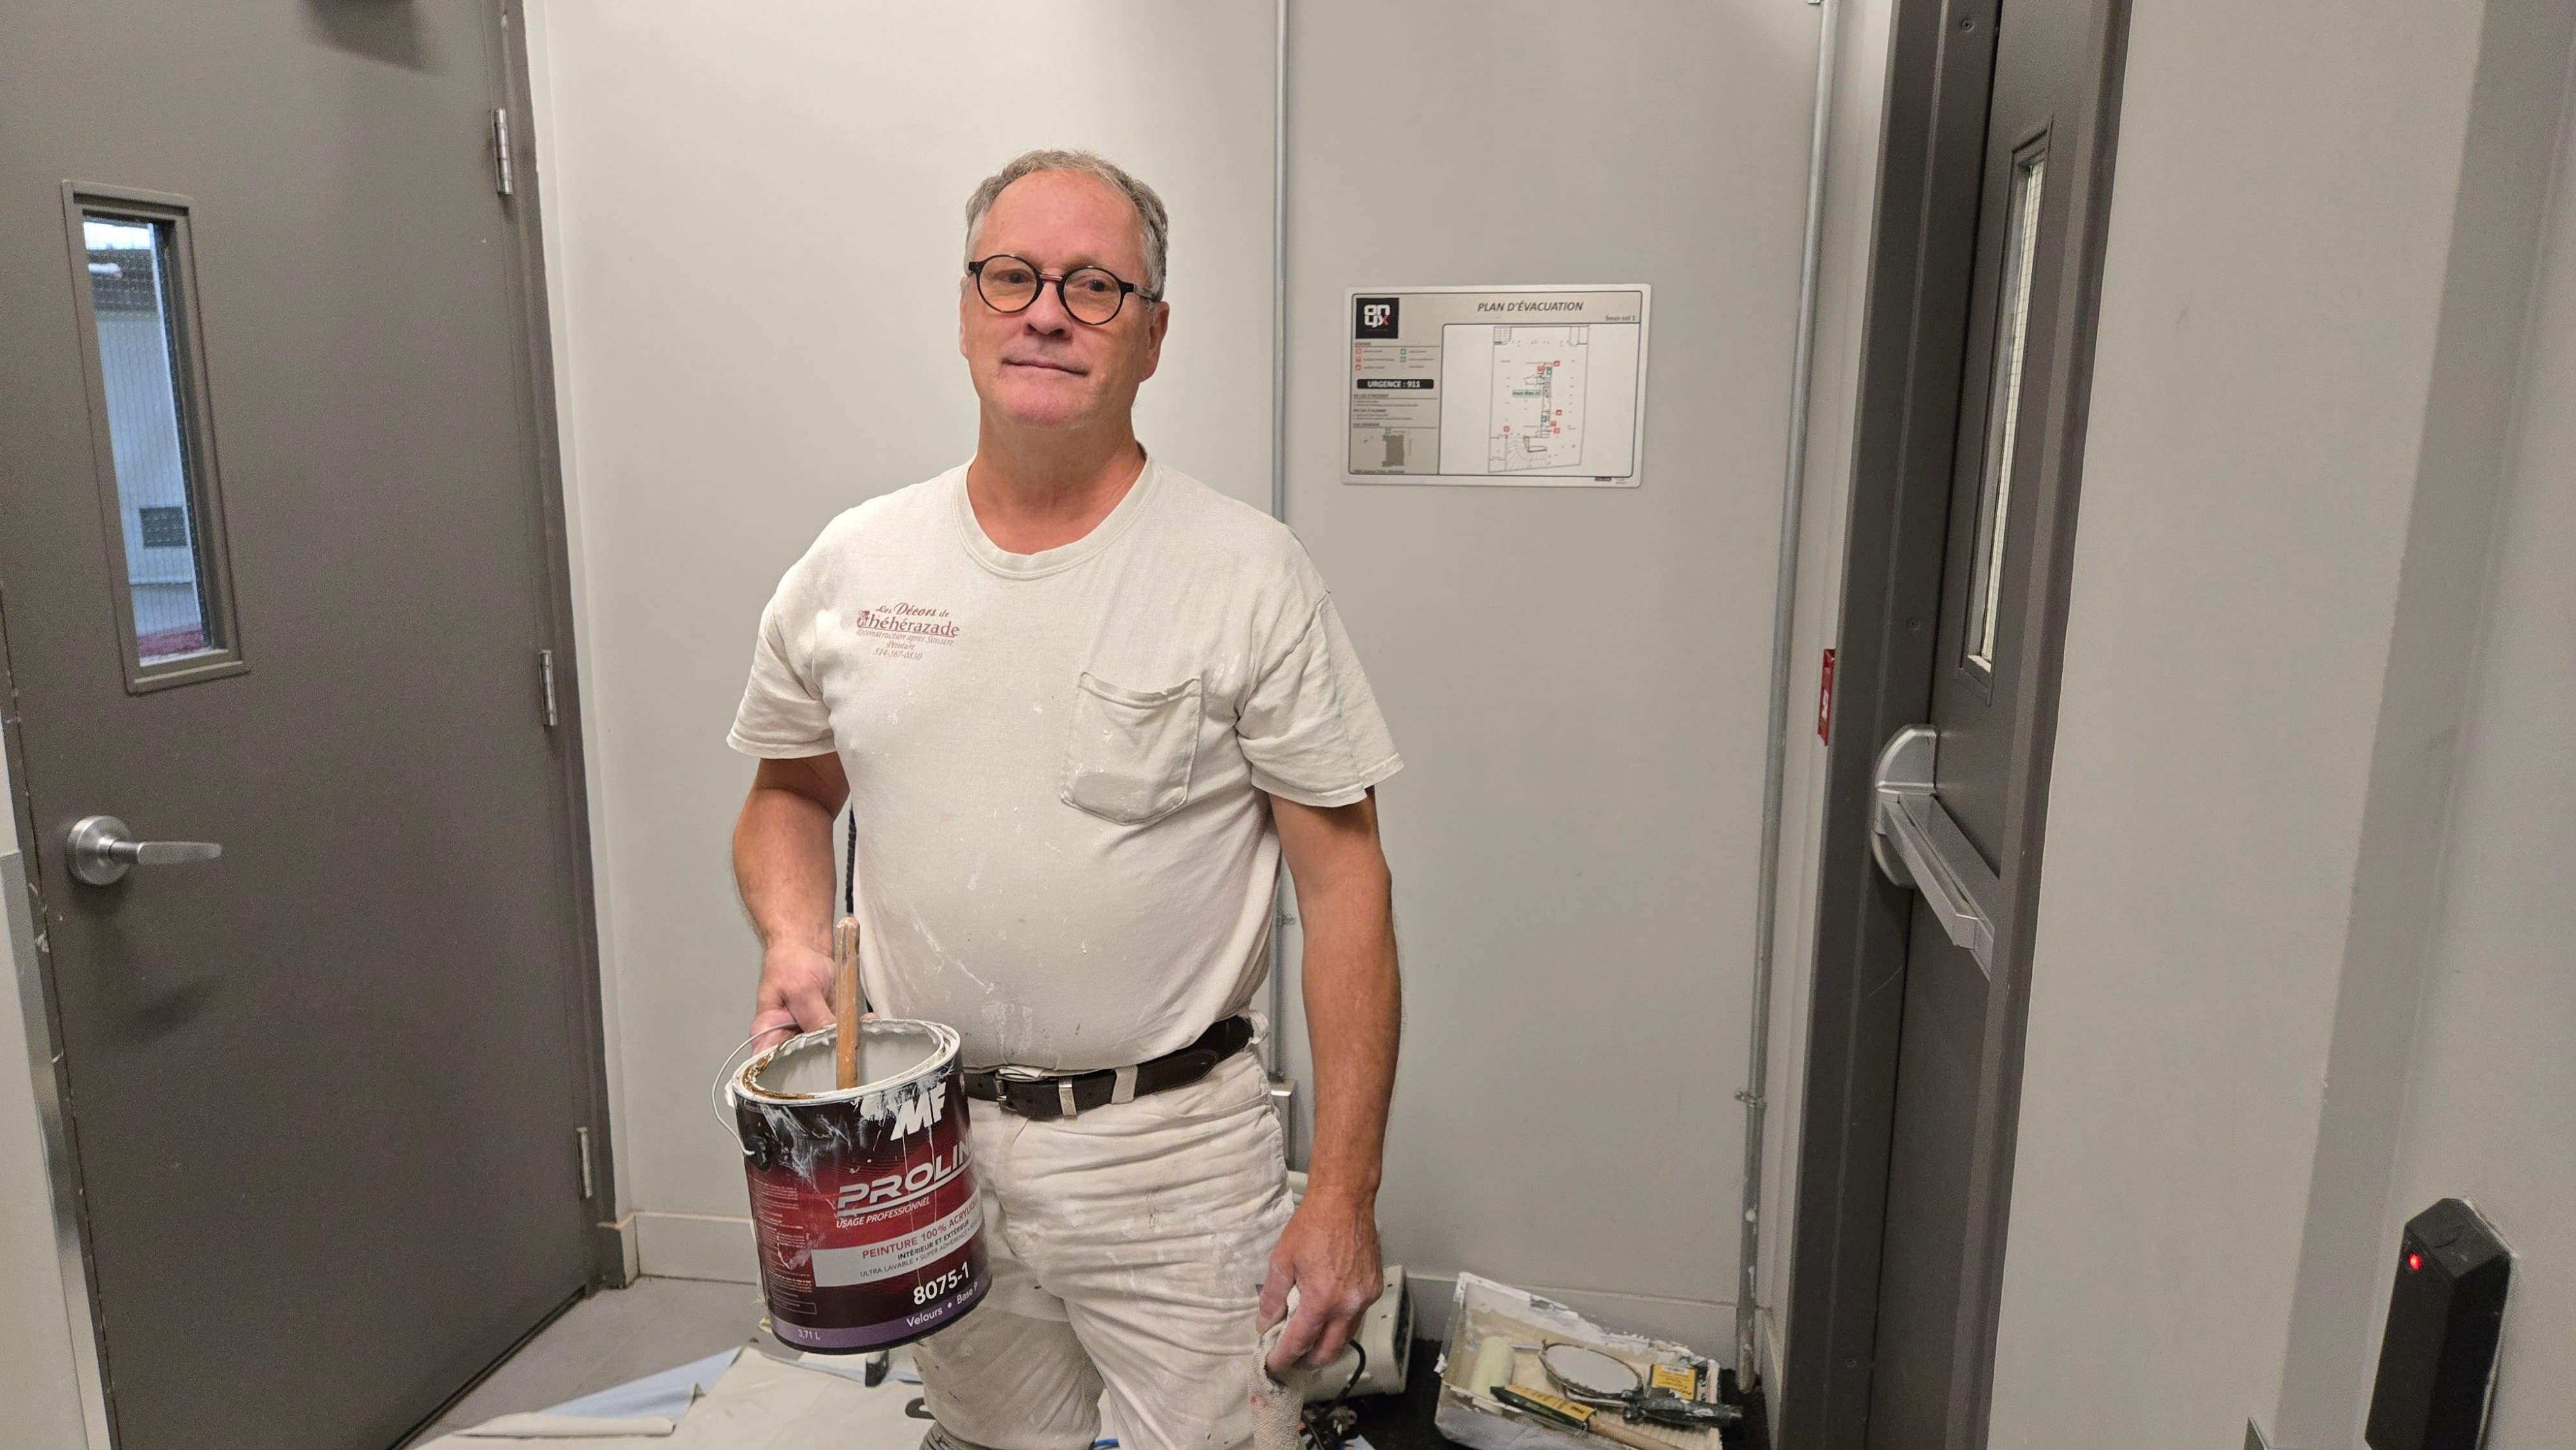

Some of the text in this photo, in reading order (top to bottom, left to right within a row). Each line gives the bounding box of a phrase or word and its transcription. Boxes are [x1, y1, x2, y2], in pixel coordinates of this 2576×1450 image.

[1477, 301, 1584, 312] PLAN D'ÉVACUATION
[876, 603, 950, 617] Les Décors de
[890, 1082, 947, 1141] MF
[837, 1133, 971, 1209] PROLIN
[836, 1196, 931, 1229] USAGE PROFESSIONNEL
[862, 1236, 918, 1259] PEINTURE
[898, 1242, 933, 1260] INTÉRIEUR
[934, 1238, 942, 1246] ET
[944, 1219, 969, 1241] EXTÉRIEUR
[860, 1268, 882, 1277] ULTRA
[884, 1258, 913, 1272] LAVABLE
[920, 1247, 938, 1260] SUPER
[913, 1261, 969, 1305] 8075-1
[906, 1307, 943, 1327] Velours
[956, 1288, 973, 1304] Base
[799, 1329, 821, 1340] 3,71 L
